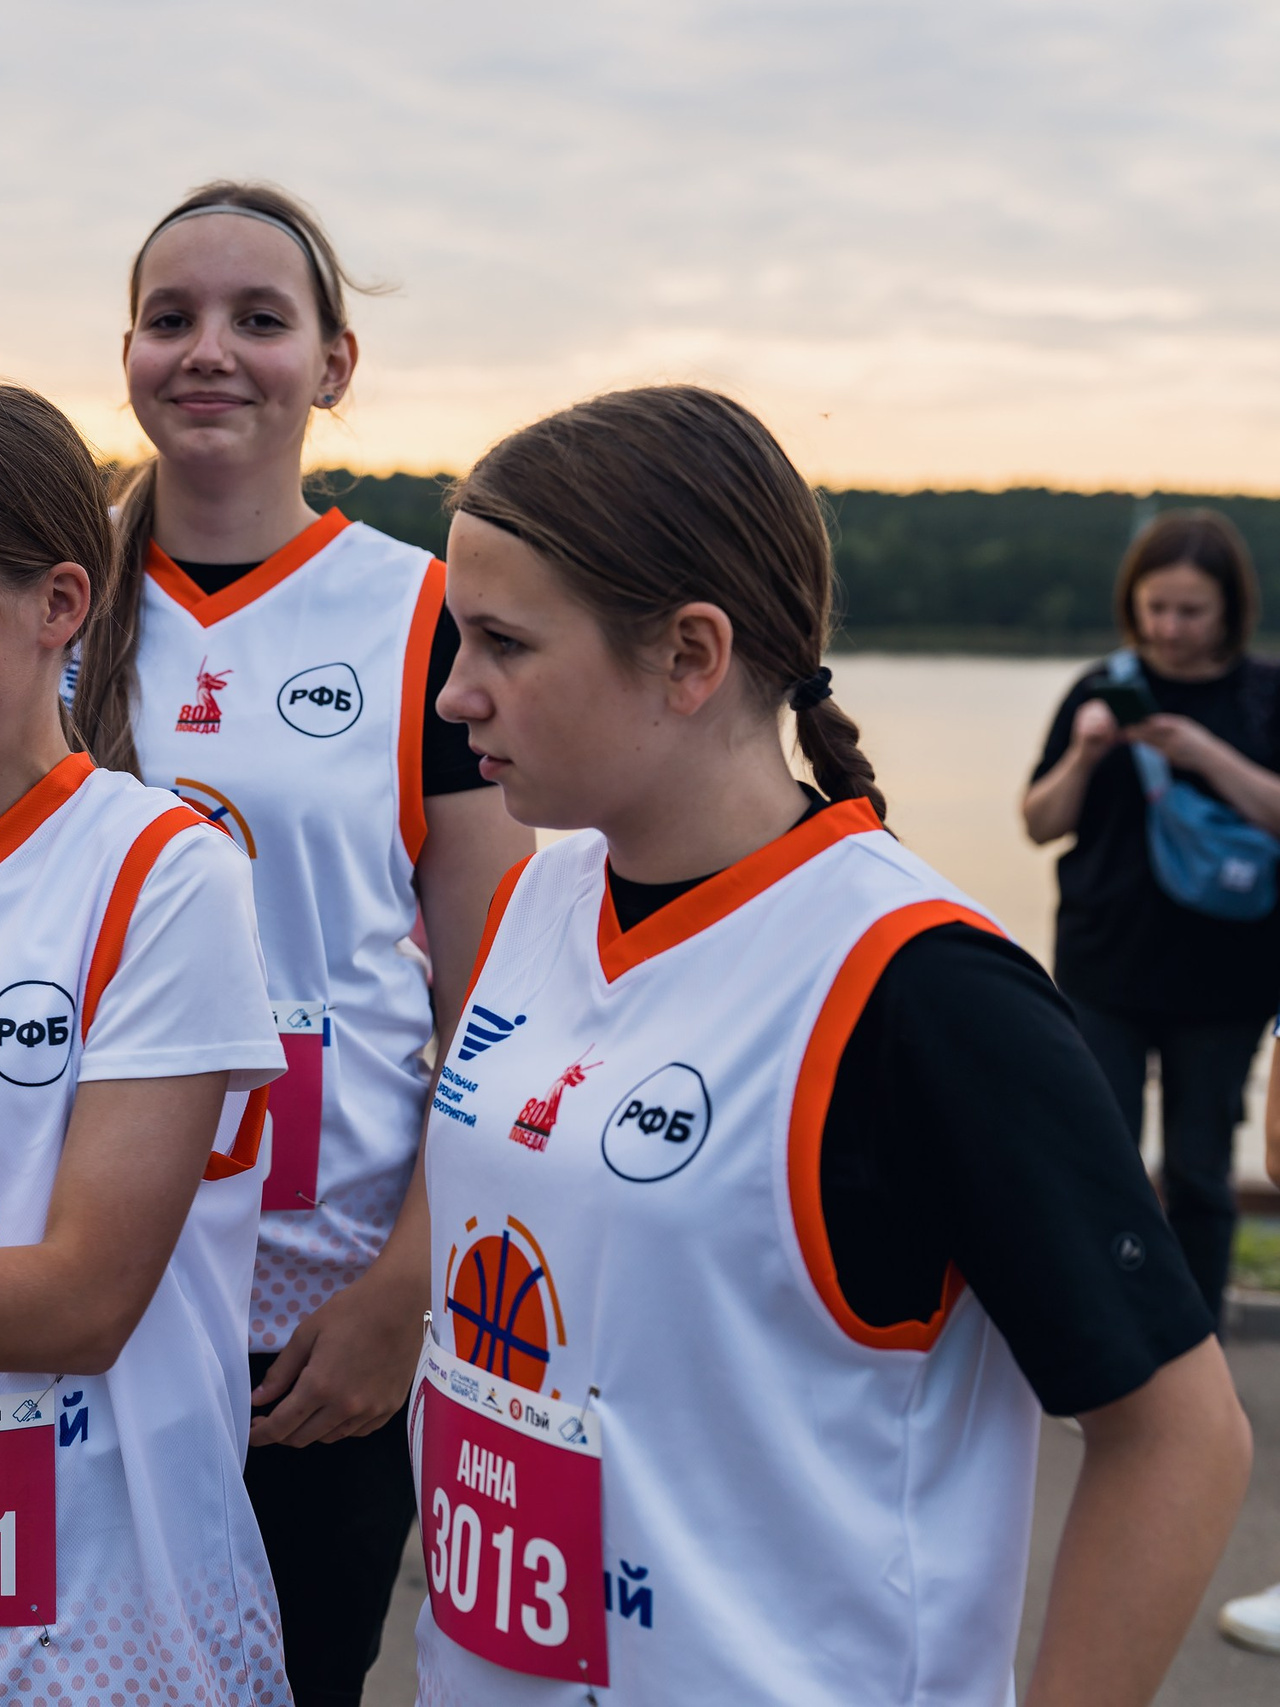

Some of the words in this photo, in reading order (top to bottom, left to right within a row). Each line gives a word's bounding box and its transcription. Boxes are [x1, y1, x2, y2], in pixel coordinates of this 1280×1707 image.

[289, 686, 352, 712] РФБ
[179, 705, 204, 721] 80
[175, 722, 220, 734] ПОБЕДА!
[518, 1098, 546, 1126] 80
[617, 1100, 695, 1143] РФБ
[509, 1126, 548, 1153] ПОБЕДА!
[525, 1405, 550, 1430] Пэй
[456, 1439, 517, 1509] АННА
[430, 1486, 570, 1647] 3013
